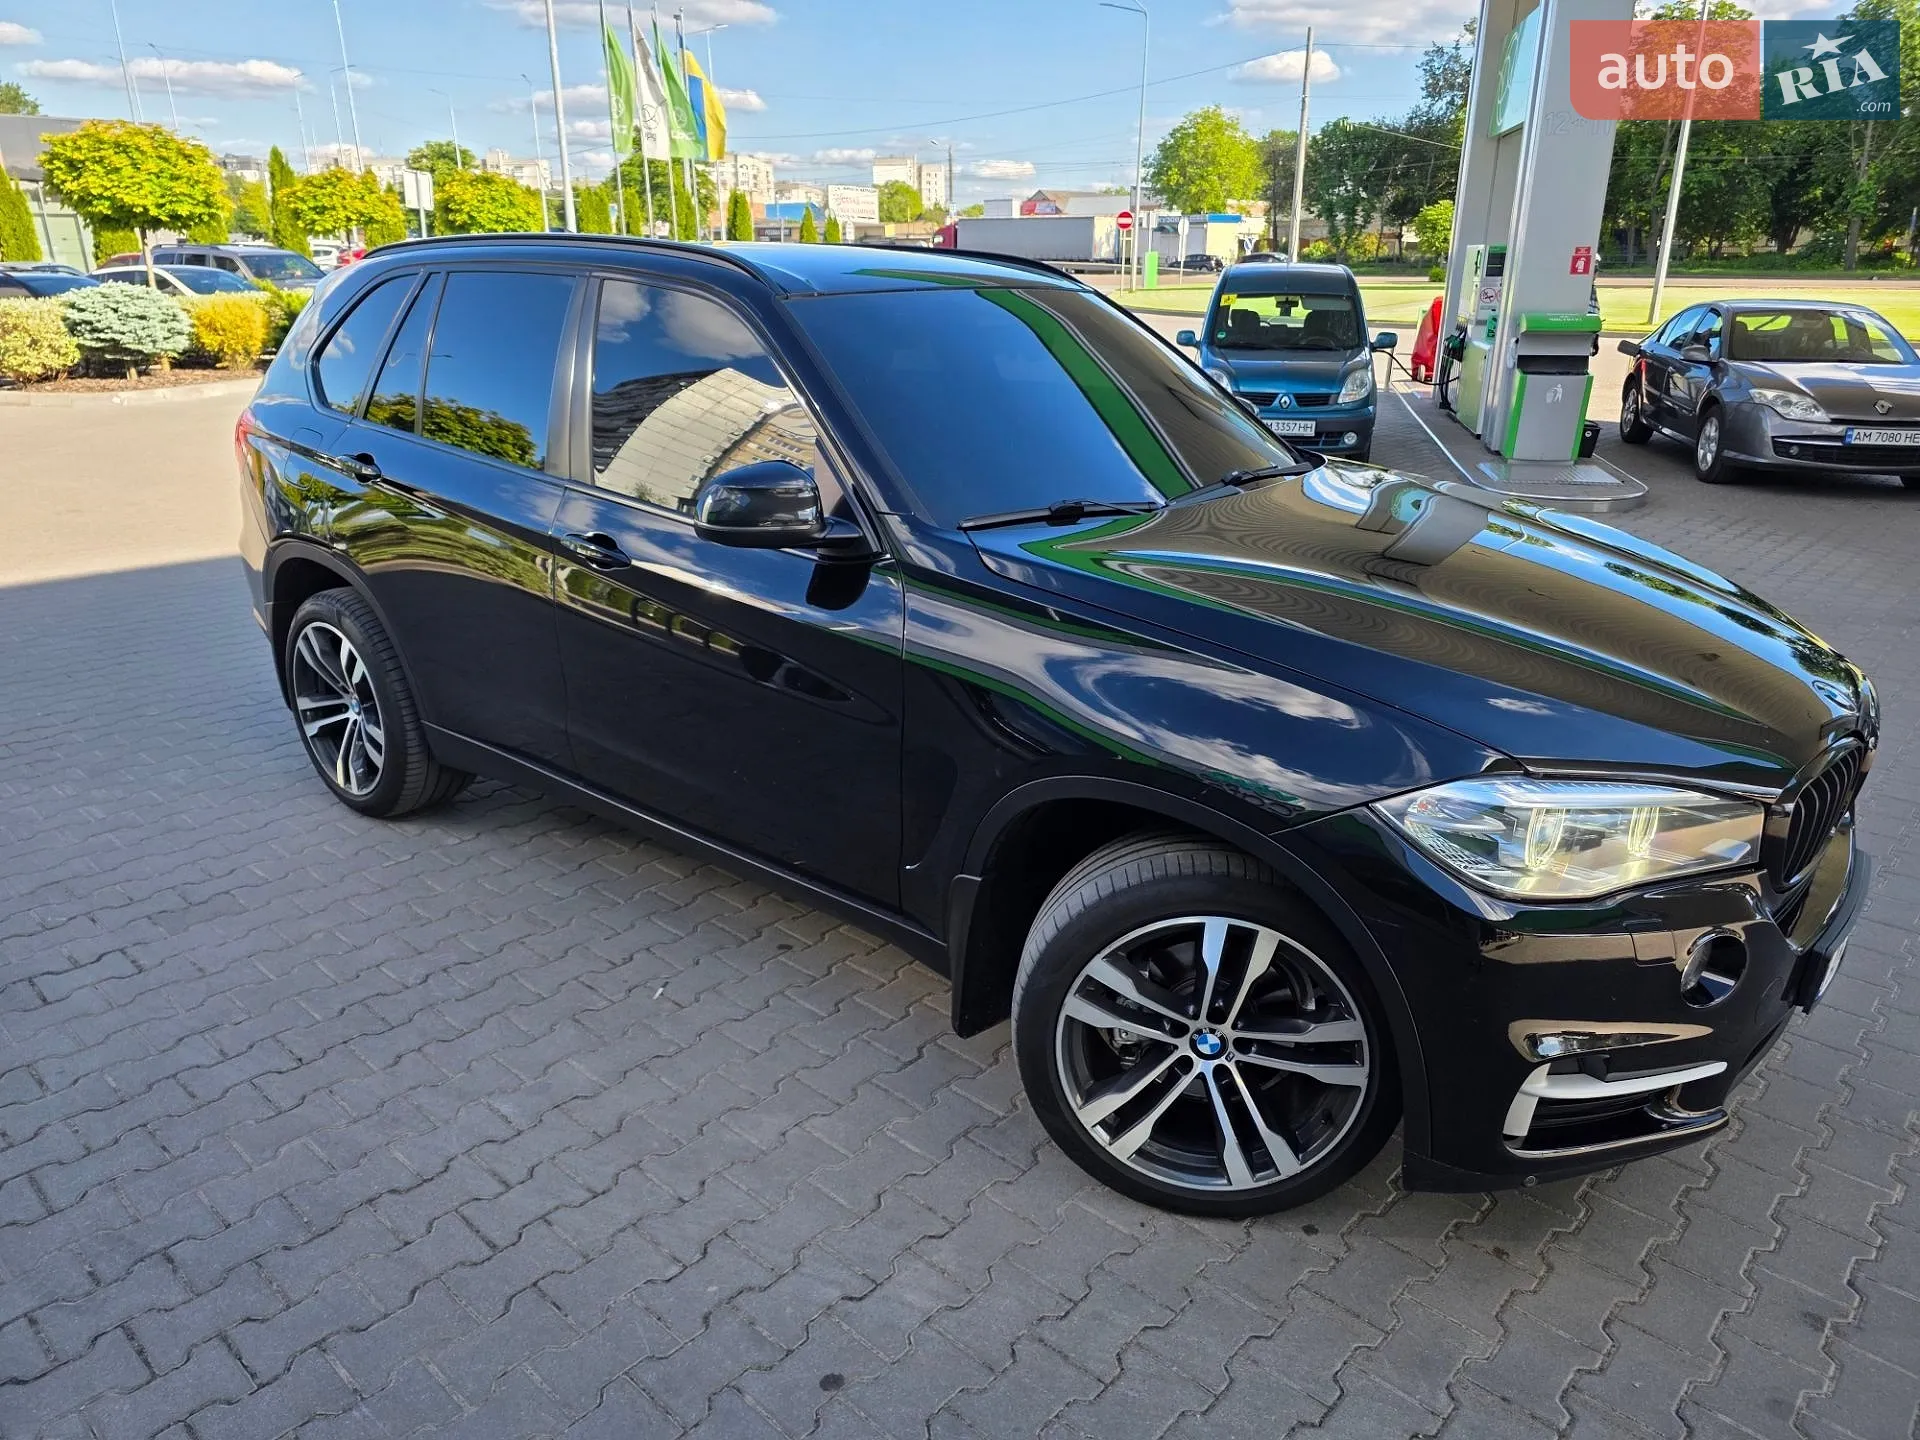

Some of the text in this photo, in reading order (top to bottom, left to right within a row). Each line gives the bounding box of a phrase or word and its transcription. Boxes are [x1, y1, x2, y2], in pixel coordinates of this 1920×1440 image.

[1274, 422, 1297, 431] 3357
[1298, 423, 1313, 432] HH
[1854, 431, 1920, 444] AM 7080 HE
[1192, 1027, 1223, 1040] BMW
